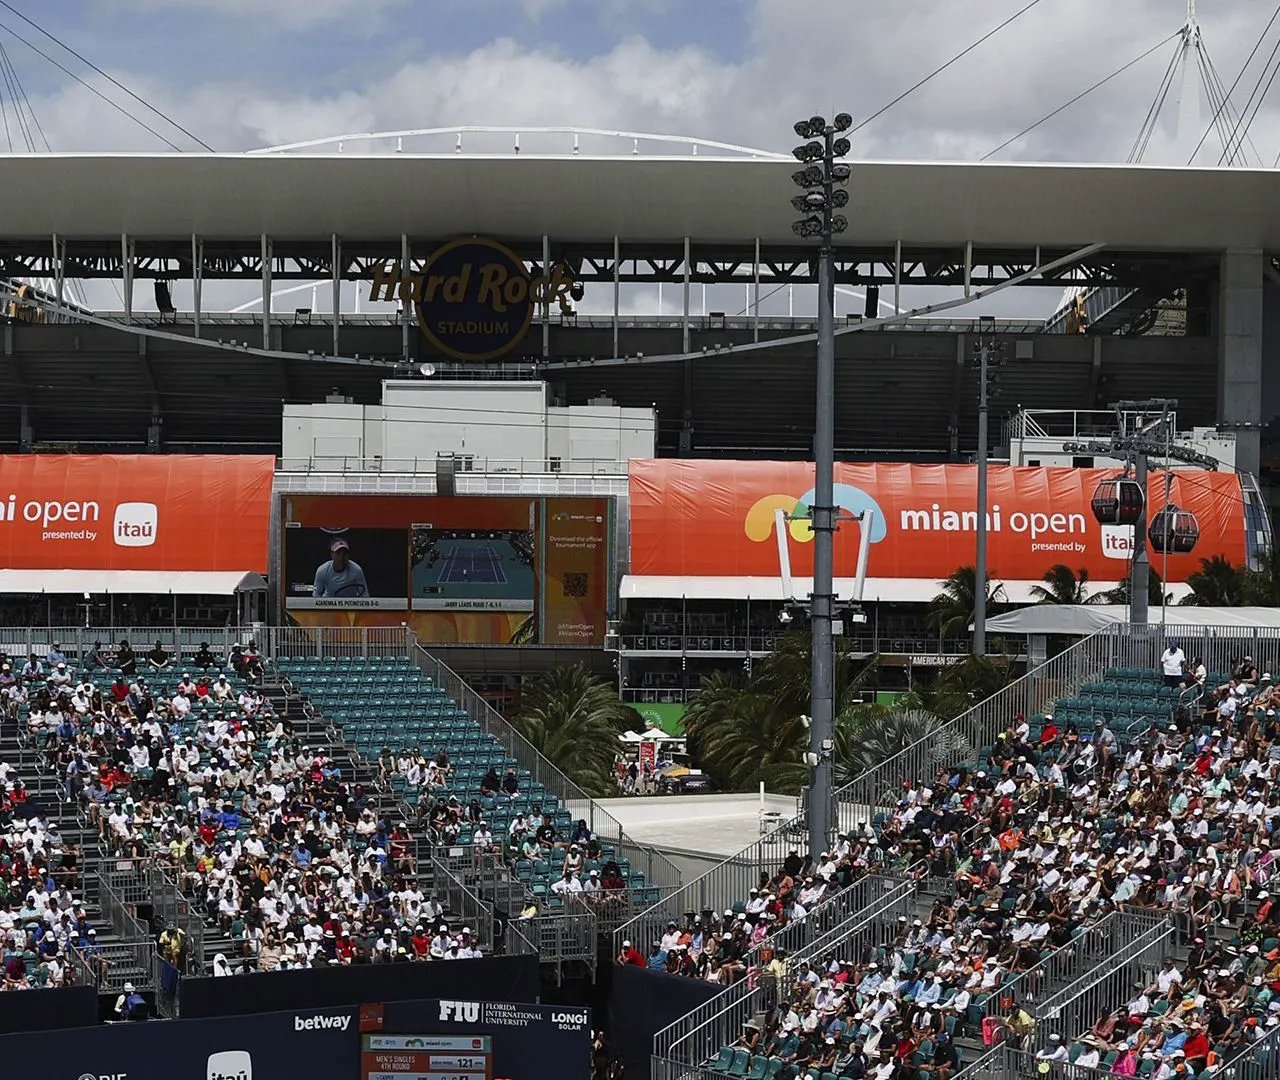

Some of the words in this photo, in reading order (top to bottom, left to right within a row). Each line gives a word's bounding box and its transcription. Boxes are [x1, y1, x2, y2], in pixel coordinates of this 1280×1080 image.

[369, 261, 473, 304] Hard
[477, 262, 575, 314] Rock
[438, 321, 510, 335] STADIUM
[23, 500, 99, 528] open
[1010, 509, 1086, 538] open
[118, 521, 152, 538] itaú
[43, 530, 84, 541] presented
[86, 531, 97, 541] by
[1031, 542, 1071, 553] presented
[1073, 543, 1086, 553] by
[912, 656, 945, 665] AMERICAN
[439, 1000, 480, 1022] FIU
[486, 1003, 516, 1011] FLORIDA
[486, 1010, 543, 1021] INTERNATIONAL
[294, 1015, 351, 1031] betway
[486, 1017, 529, 1026] UNIVERSITY
[558, 1023, 581, 1031] SOLAR
[457, 1058, 473, 1068] 121
